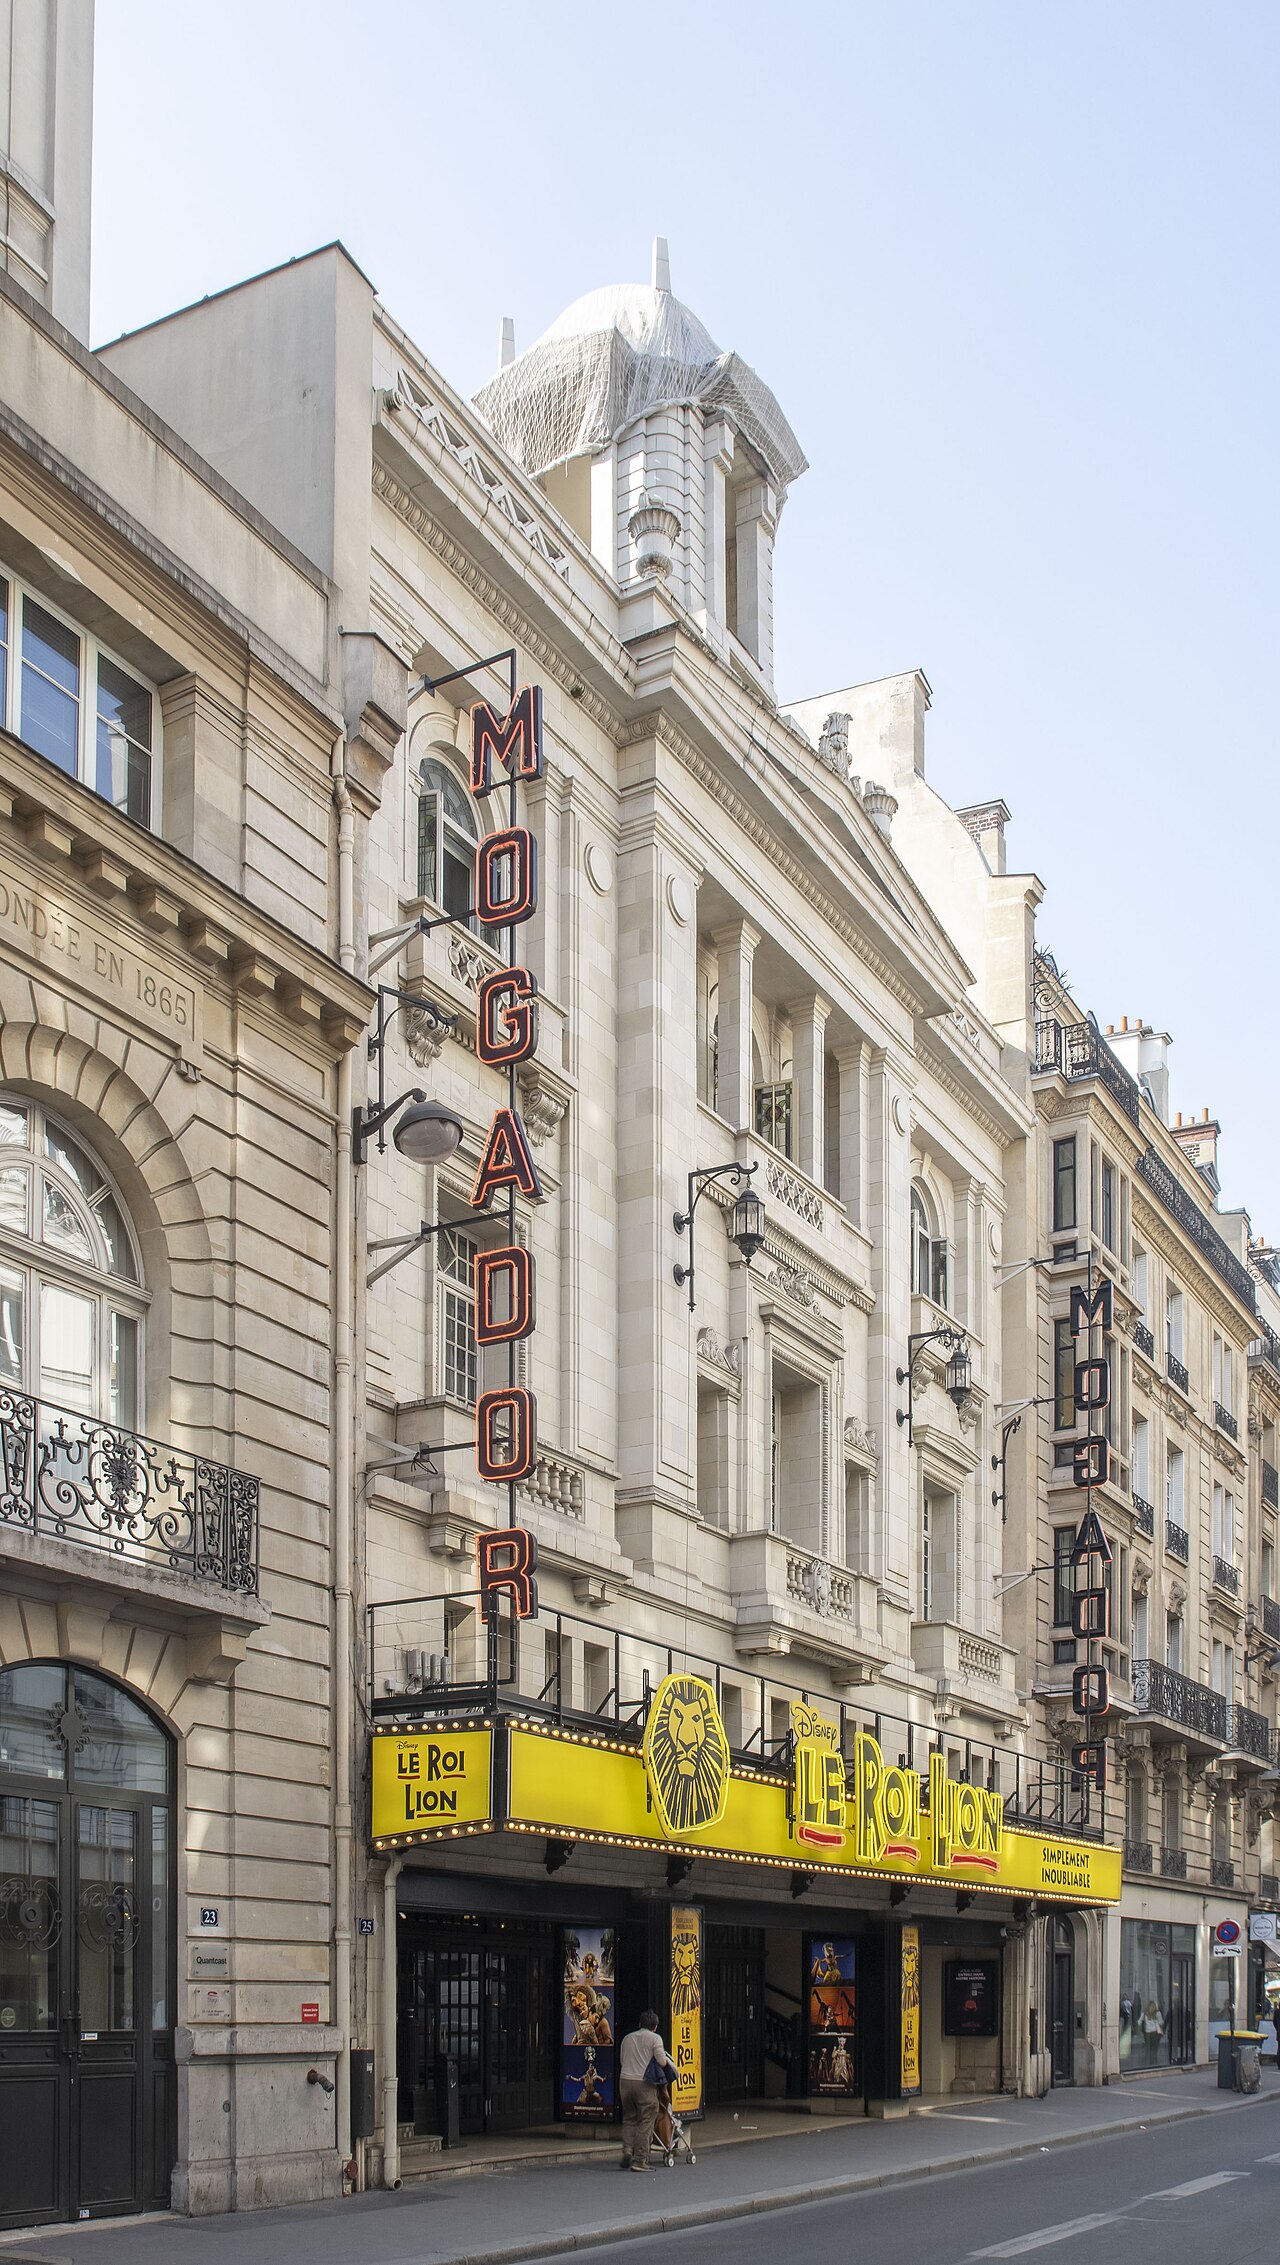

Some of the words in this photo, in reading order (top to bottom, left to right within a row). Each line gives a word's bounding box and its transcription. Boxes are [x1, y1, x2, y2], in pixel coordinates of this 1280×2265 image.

[93, 941, 125, 988] EN
[136, 968, 187, 1026] 1865
[469, 683, 543, 1623] MOGADOR
[398, 1753, 420, 1774] LE
[427, 1744, 465, 1781] ROI
[405, 1784, 457, 1820] LION
[798, 1747, 847, 1829] LE
[855, 1732, 921, 1862] ROI
[930, 1753, 1004, 1870] LION
[1042, 1847, 1090, 1869] SIMPLEMENT
[1041, 1867, 1091, 1889] INOUBLIABLE
[203, 1910, 216, 1924] 23
[361, 1920, 372, 1932] 25
[196, 1956, 227, 1965] Quantcast
[681, 2027, 690, 2039] LE
[677, 2044, 693, 2068] ROI
